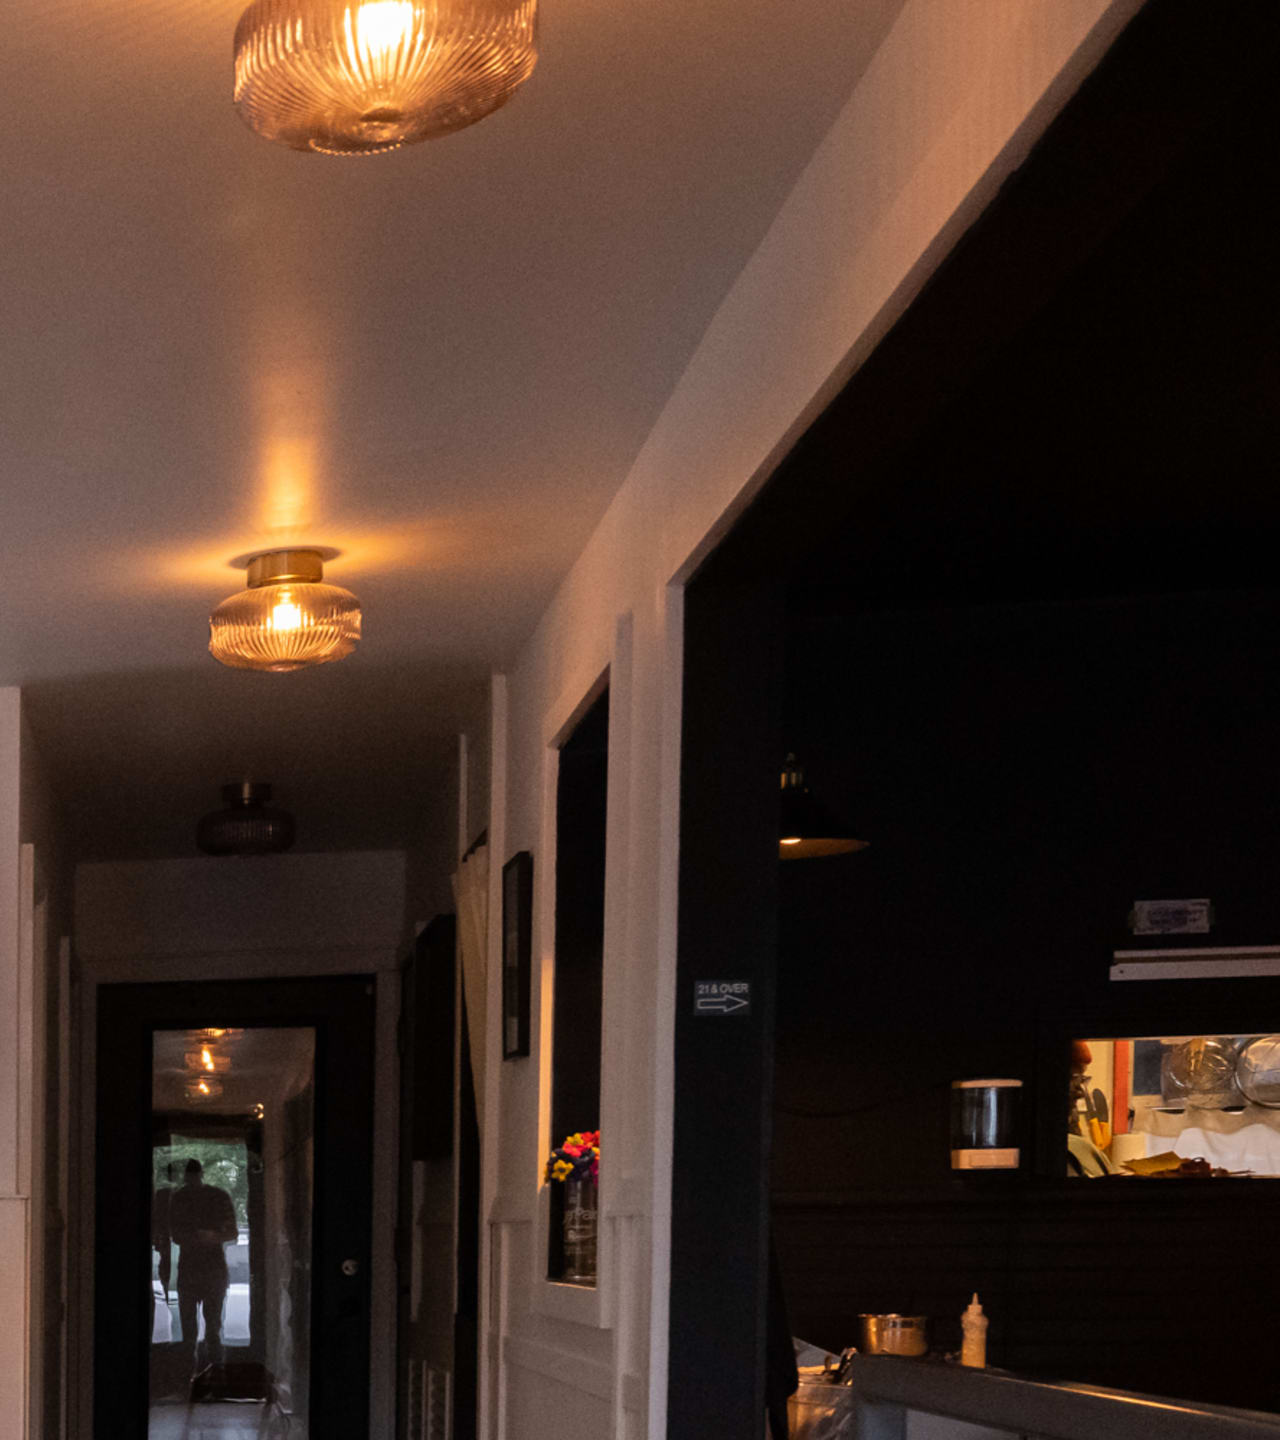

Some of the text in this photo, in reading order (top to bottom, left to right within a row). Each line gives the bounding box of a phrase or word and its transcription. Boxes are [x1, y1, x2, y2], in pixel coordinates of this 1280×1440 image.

[698, 983, 749, 994] 21 & OVER
